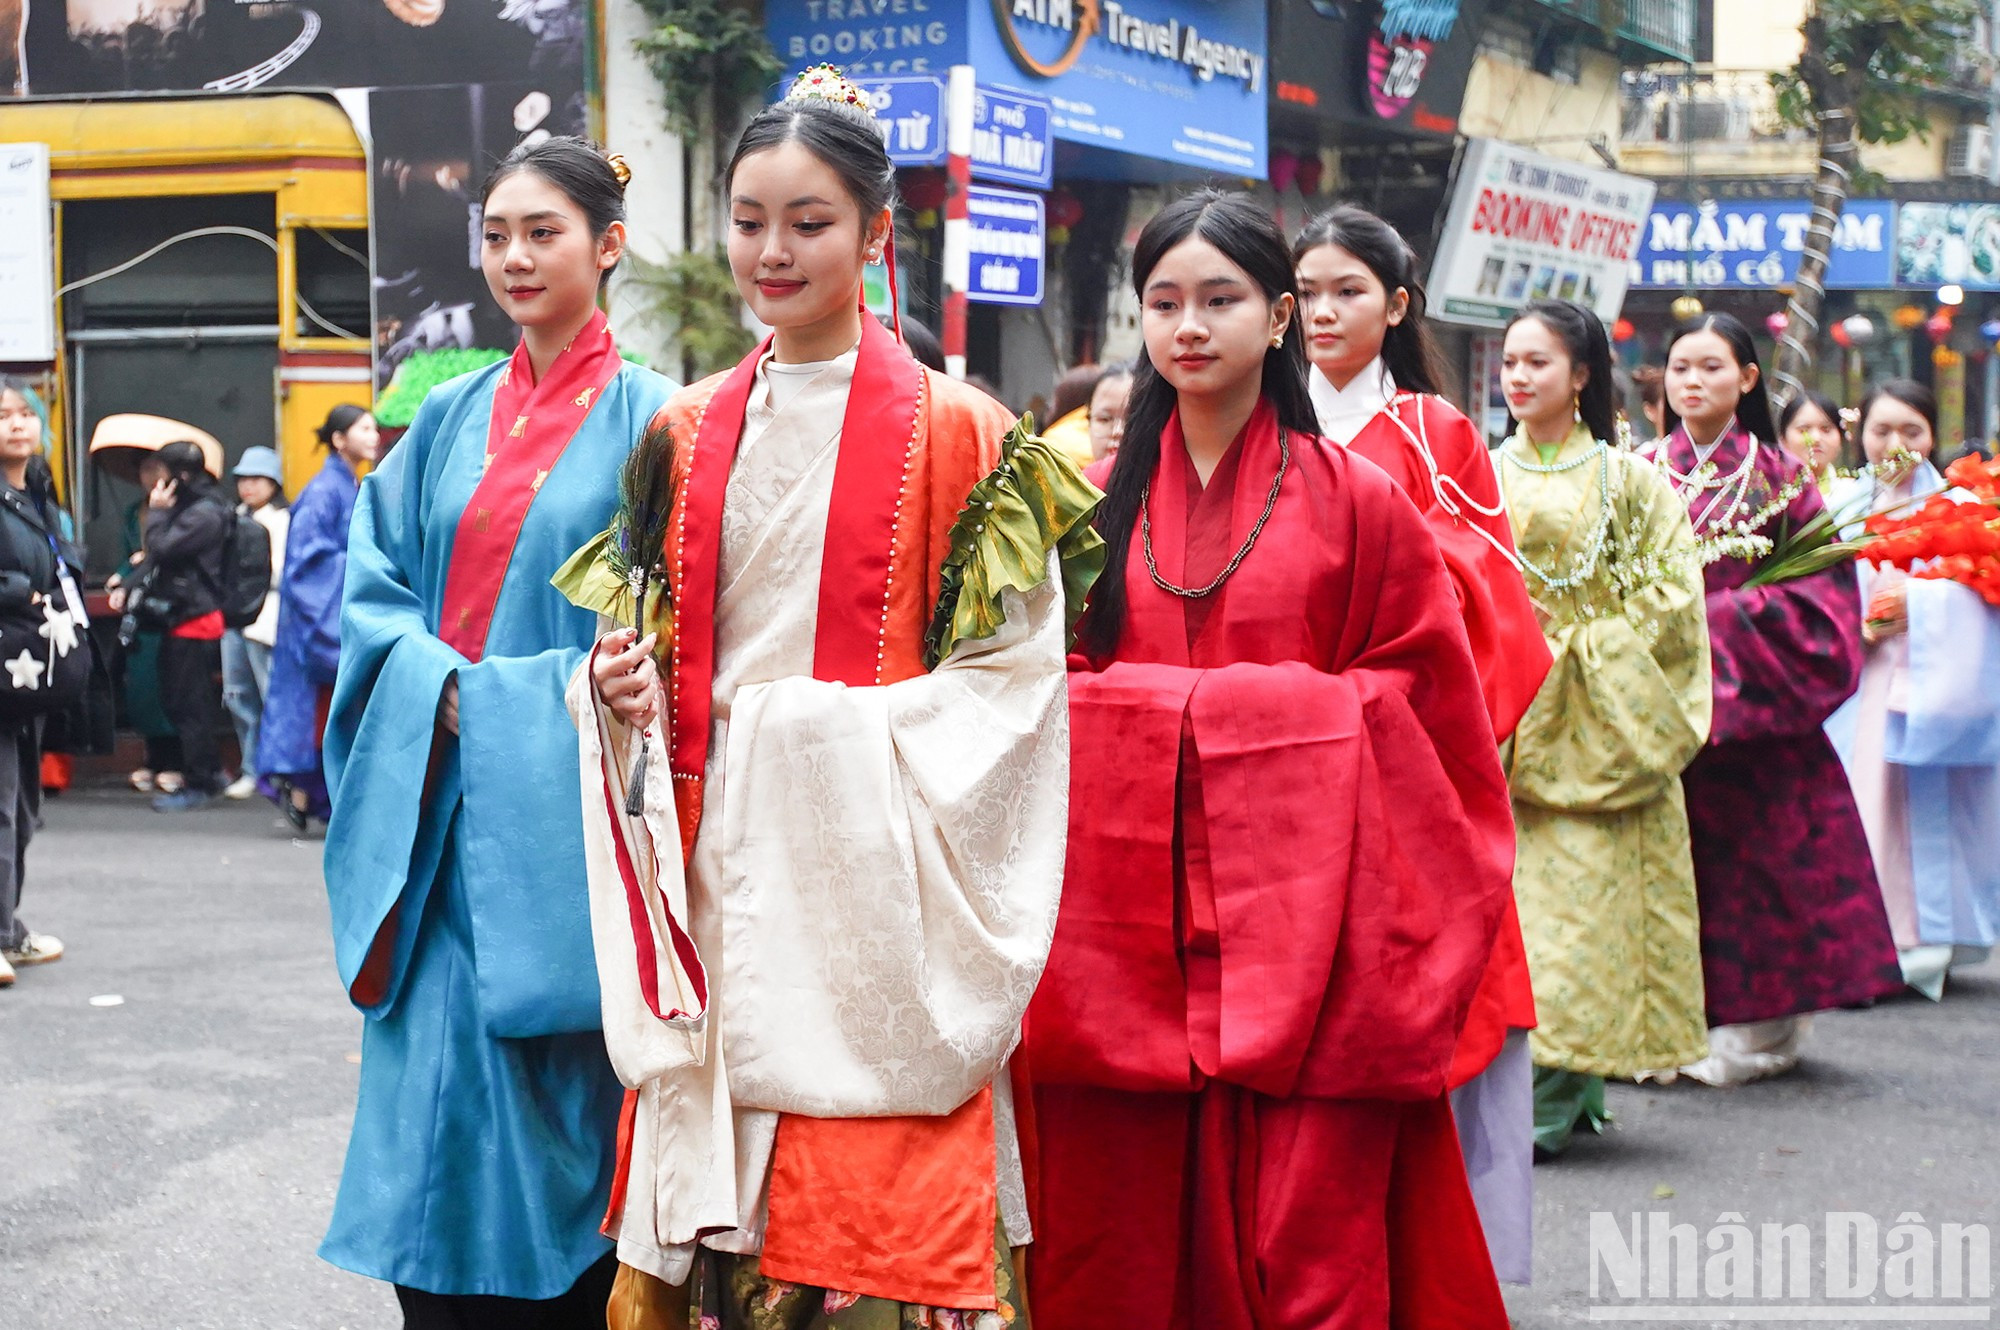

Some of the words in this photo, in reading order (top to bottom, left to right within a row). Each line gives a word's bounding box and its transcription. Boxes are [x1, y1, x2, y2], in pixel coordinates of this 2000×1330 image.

[807, 0, 930, 21] TRAVEL
[788, 21, 948, 58] BOOKING
[1104, 1, 1179, 61] Travel
[1182, 25, 1265, 93] Agency
[896, 110, 932, 151] TỪ
[993, 104, 1027, 129] PHỐ
[1472, 187, 1570, 247] BOOKING
[1569, 209, 1638, 261] OFFICE
[1775, 212, 1884, 252] TM
[1652, 251, 1727, 285] PHỐ
